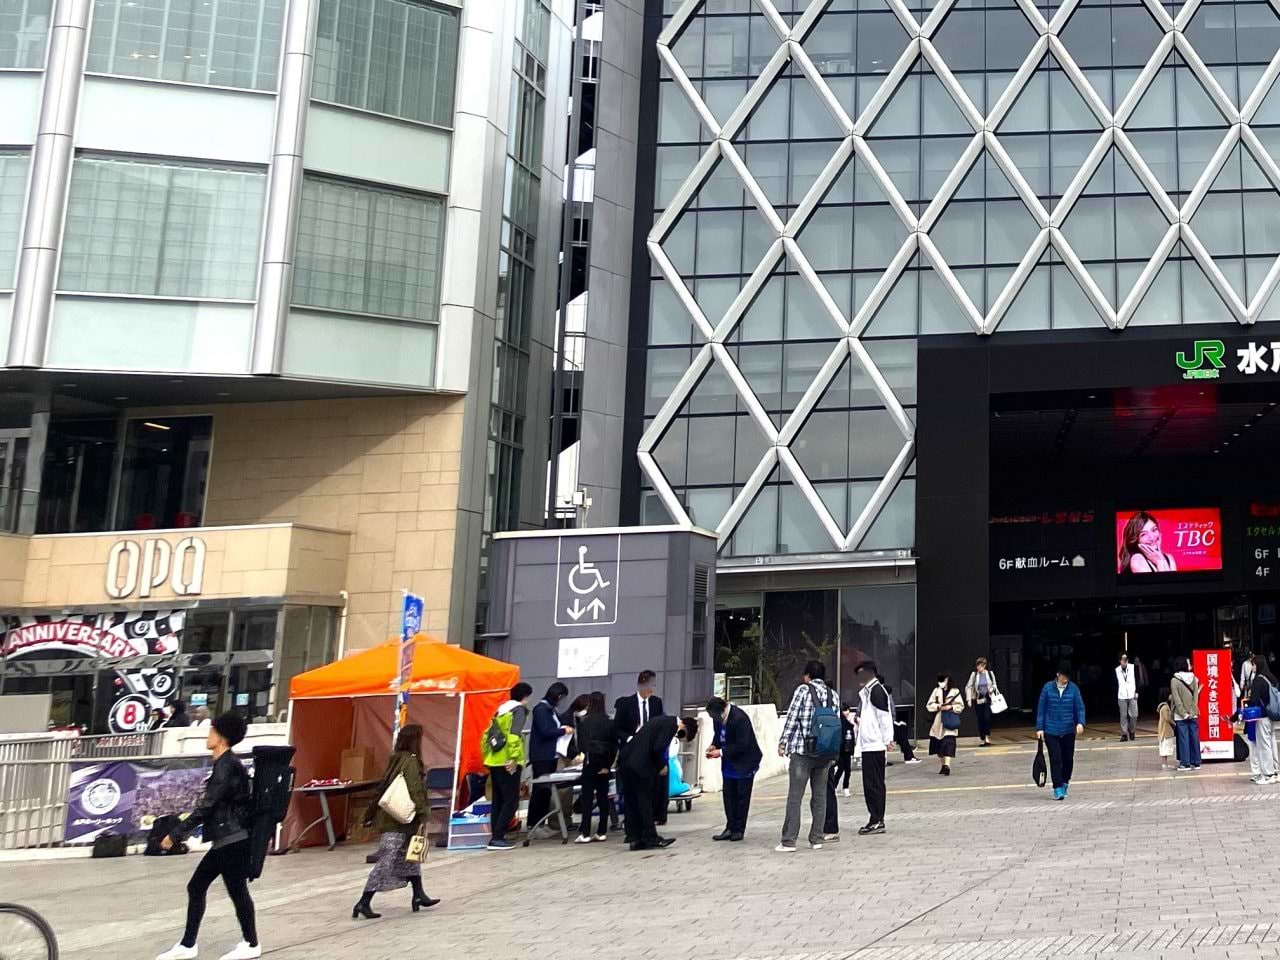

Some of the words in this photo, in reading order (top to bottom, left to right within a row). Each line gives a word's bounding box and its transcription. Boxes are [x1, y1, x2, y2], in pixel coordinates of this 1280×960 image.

[1176, 339, 1226, 369] JR
[1174, 529, 1216, 548] TBC
[1254, 548, 1270, 560] 6F
[1255, 565, 1271, 578] 4F
[8, 622, 140, 658] ANNIVERSARY
[1206, 653, 1220, 739] 国境なき医師団
